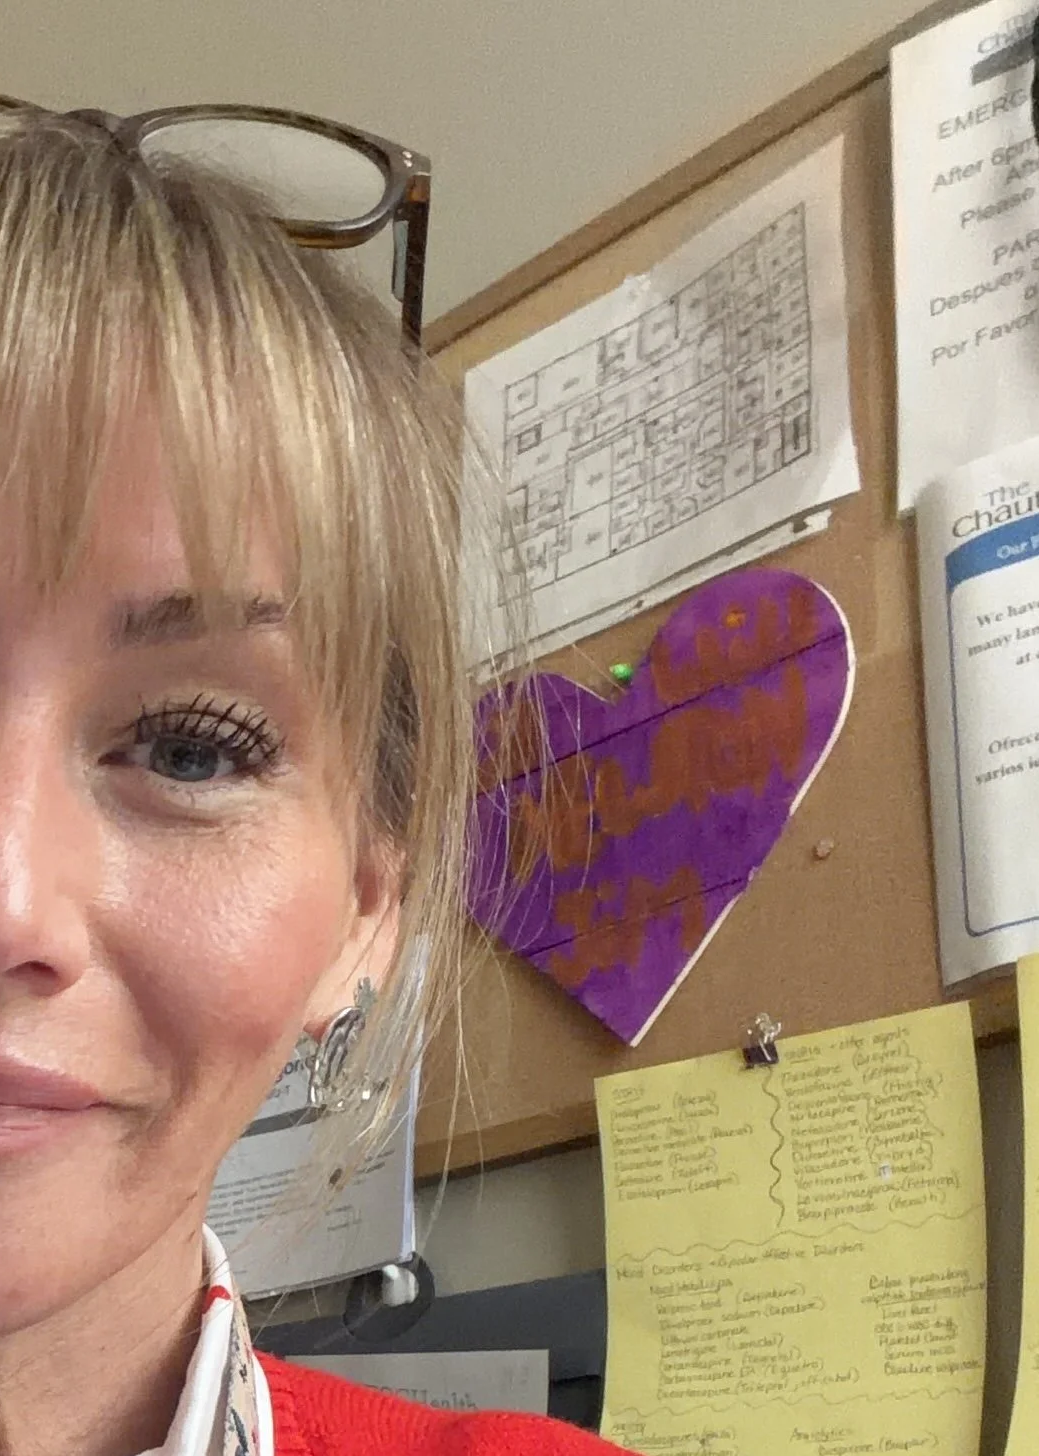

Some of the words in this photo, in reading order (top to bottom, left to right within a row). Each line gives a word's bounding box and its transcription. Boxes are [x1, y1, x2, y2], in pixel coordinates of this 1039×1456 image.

[932, 158, 984, 193] After
[960, 187, 1035, 230] Please
[931, 340, 968, 368] Por
[973, 309, 1039, 347] Favor
[981, 480, 1030, 507] The
[996, 541, 1029, 560] Our
[976, 612, 1004, 628] We
[967, 634, 1012, 657] many
[974, 762, 1025, 785] varios
